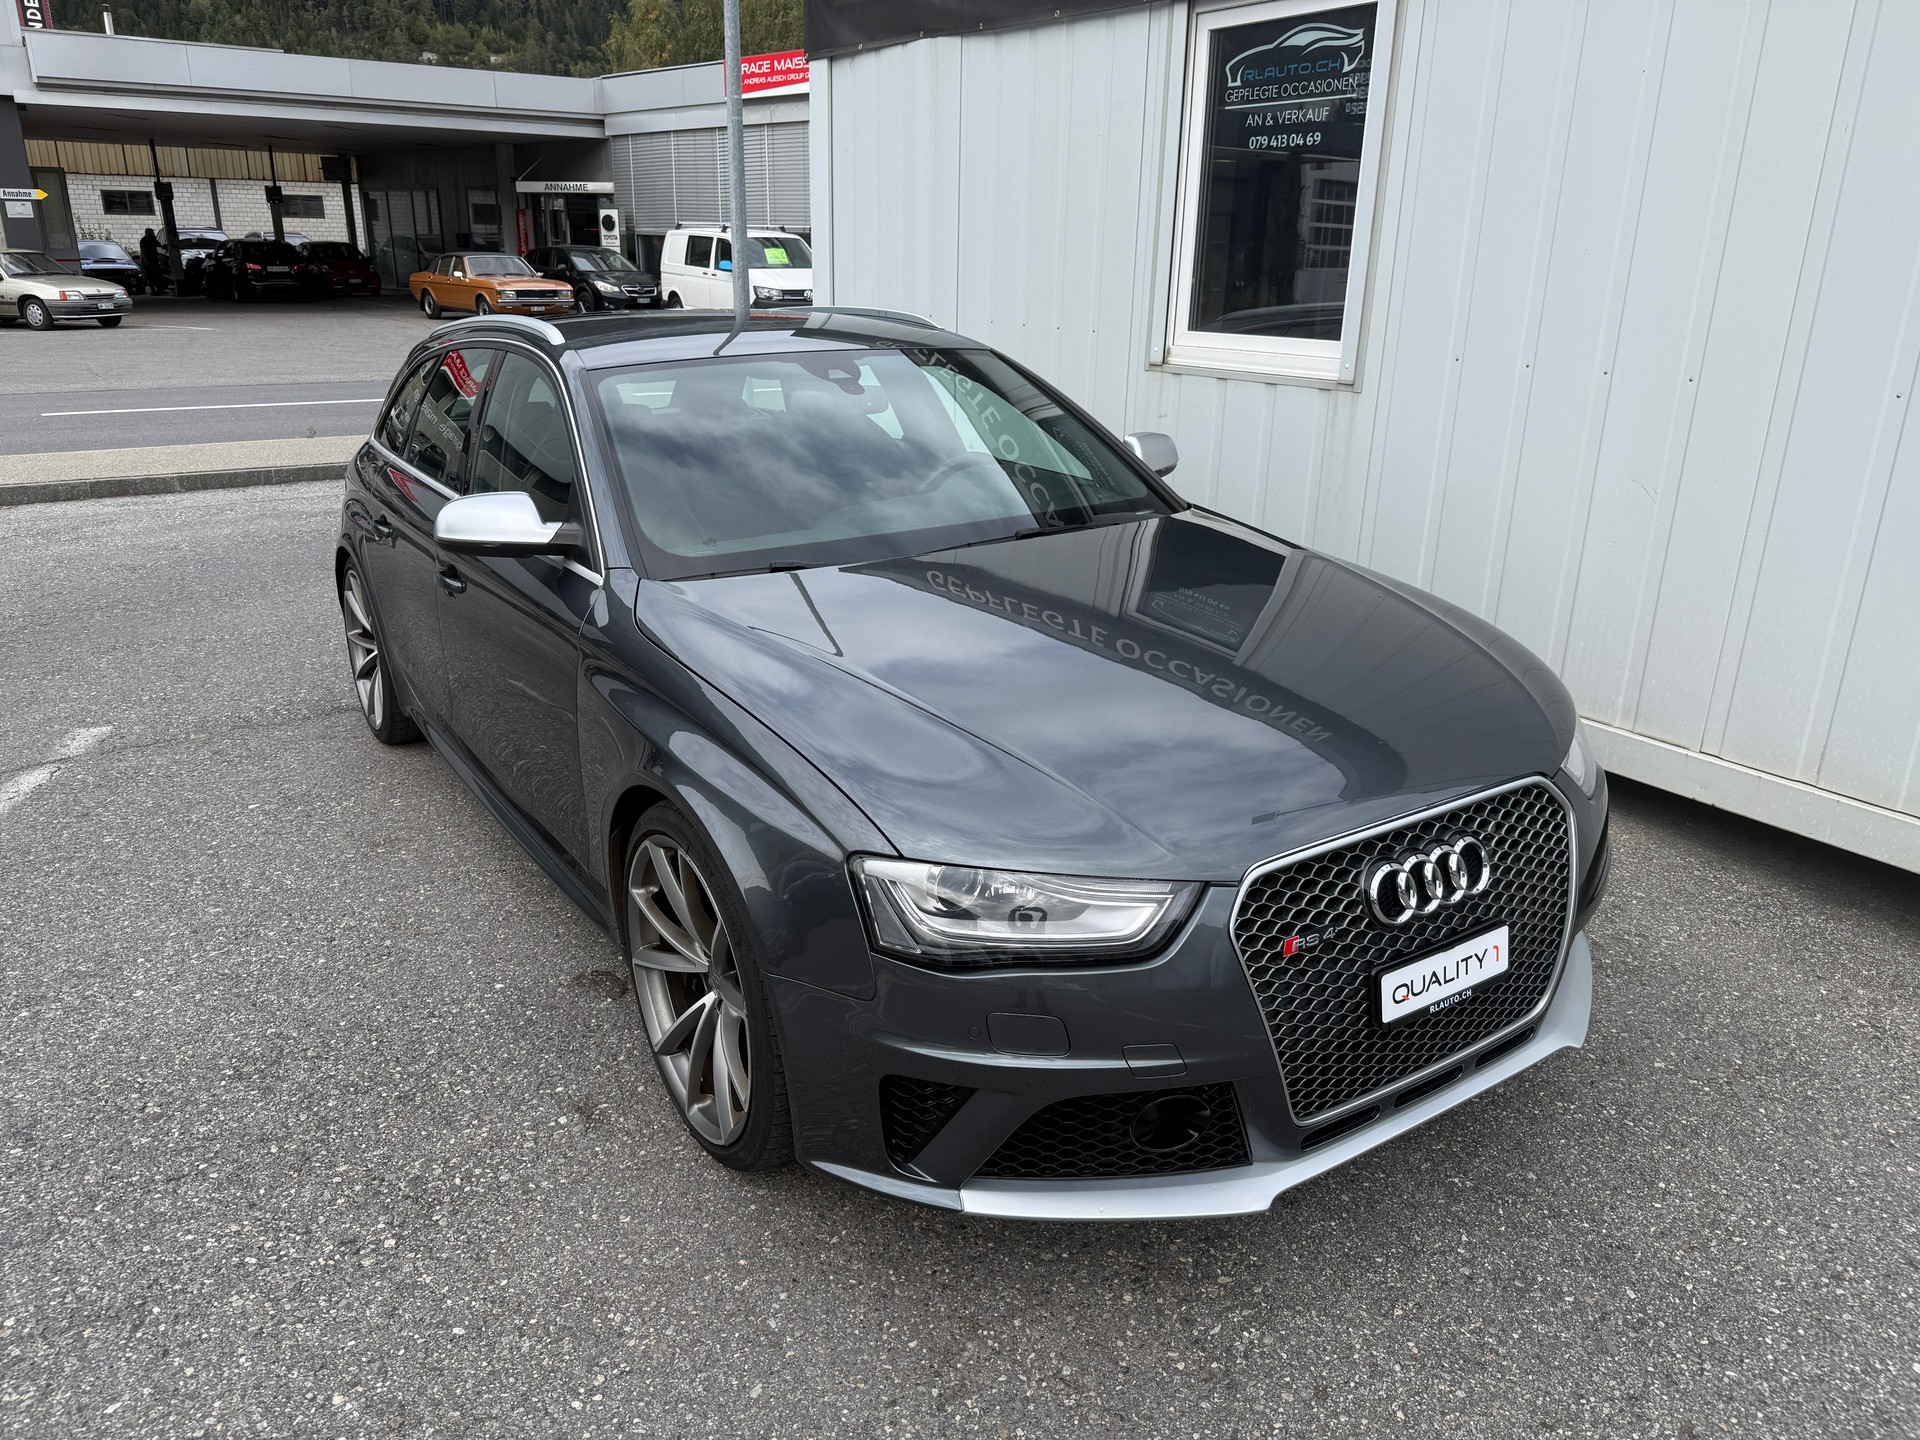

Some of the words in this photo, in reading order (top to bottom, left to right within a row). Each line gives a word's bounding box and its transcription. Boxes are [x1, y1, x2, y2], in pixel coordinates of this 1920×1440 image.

[787, 73, 804, 81] GROUP
[1243, 59, 1341, 81] RLAUTO.CH
[1225, 85, 1279, 102] GEPFLEGTE
[1281, 77, 1357, 97] OCCASIONEN
[1245, 113, 1262, 127] AN
[1265, 112, 1274, 126] &
[1277, 107, 1330, 124] VERKAUF
[1249, 136, 1268, 149] 079
[1270, 134, 1287, 148] 413
[1289, 133, 1304, 147] 04
[1306, 132, 1321, 146] 69
[2, 190, 32, 198] Annahme
[544, 183, 589, 192] ANNAHME
[1392, 948, 1488, 1005] QUALITY
[1493, 945, 1499, 962] 1
[1429, 989, 1472, 1013] RLAUTO.CH
